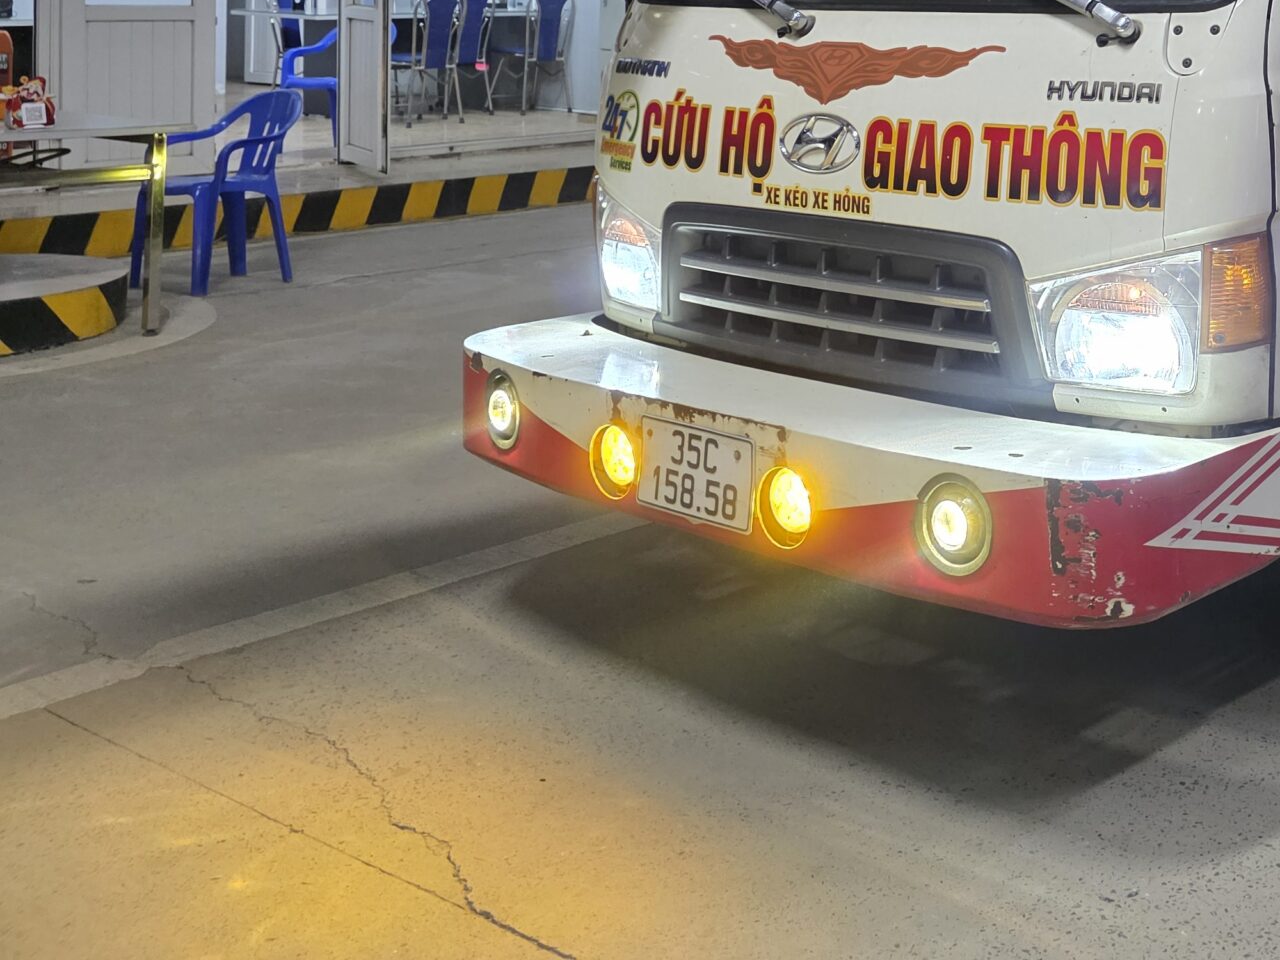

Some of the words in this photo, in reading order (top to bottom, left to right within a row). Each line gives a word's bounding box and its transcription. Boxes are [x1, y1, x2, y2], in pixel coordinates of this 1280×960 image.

[1047, 79, 1162, 104] HYUNDAI
[640, 88, 711, 172] CỨU
[718, 95, 776, 195] HỘ
[862, 116, 974, 199] GIAO
[982, 111, 1167, 211] THÔNG
[765, 186, 780, 205] XE
[784, 185, 808, 208] KÉO
[812, 190, 828, 210] XE
[671, 430, 719, 474] 35C
[653, 465, 738, 521] 158.58
